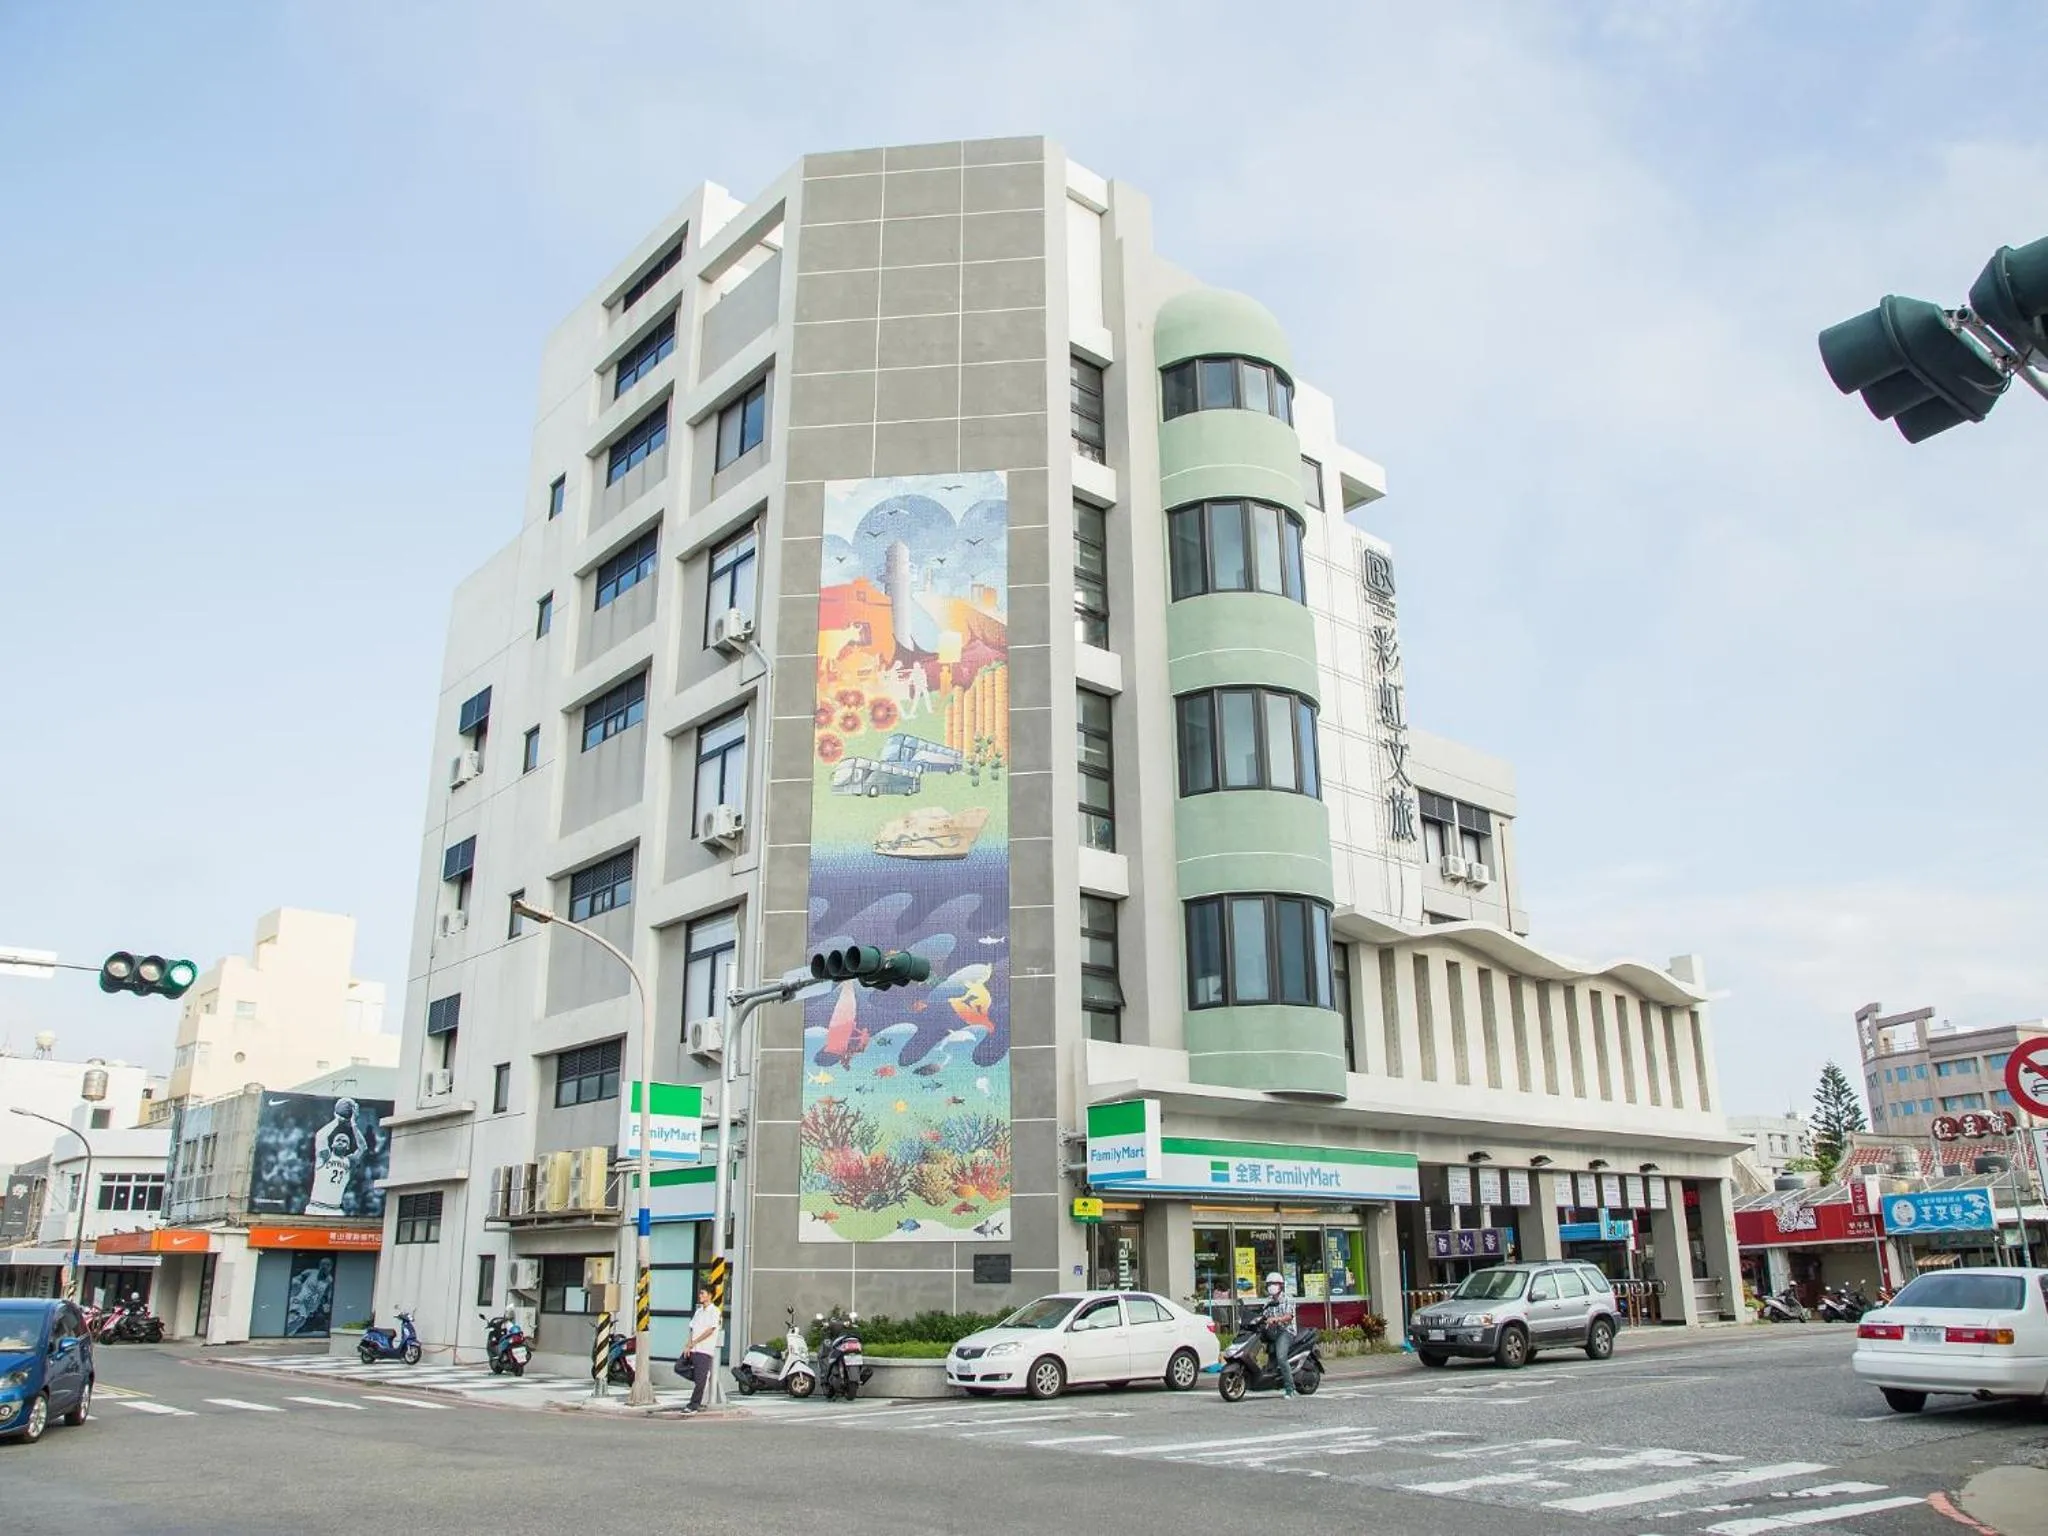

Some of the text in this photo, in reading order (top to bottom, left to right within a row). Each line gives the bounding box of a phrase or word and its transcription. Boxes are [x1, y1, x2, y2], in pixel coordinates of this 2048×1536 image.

[1371, 626, 1417, 842] 彩虹文旅
[631, 1124, 697, 1142] FmilyMart
[1090, 1146, 1145, 1164] FamilyMart
[1235, 1163, 1342, 1187] 全家 FamilyMart
